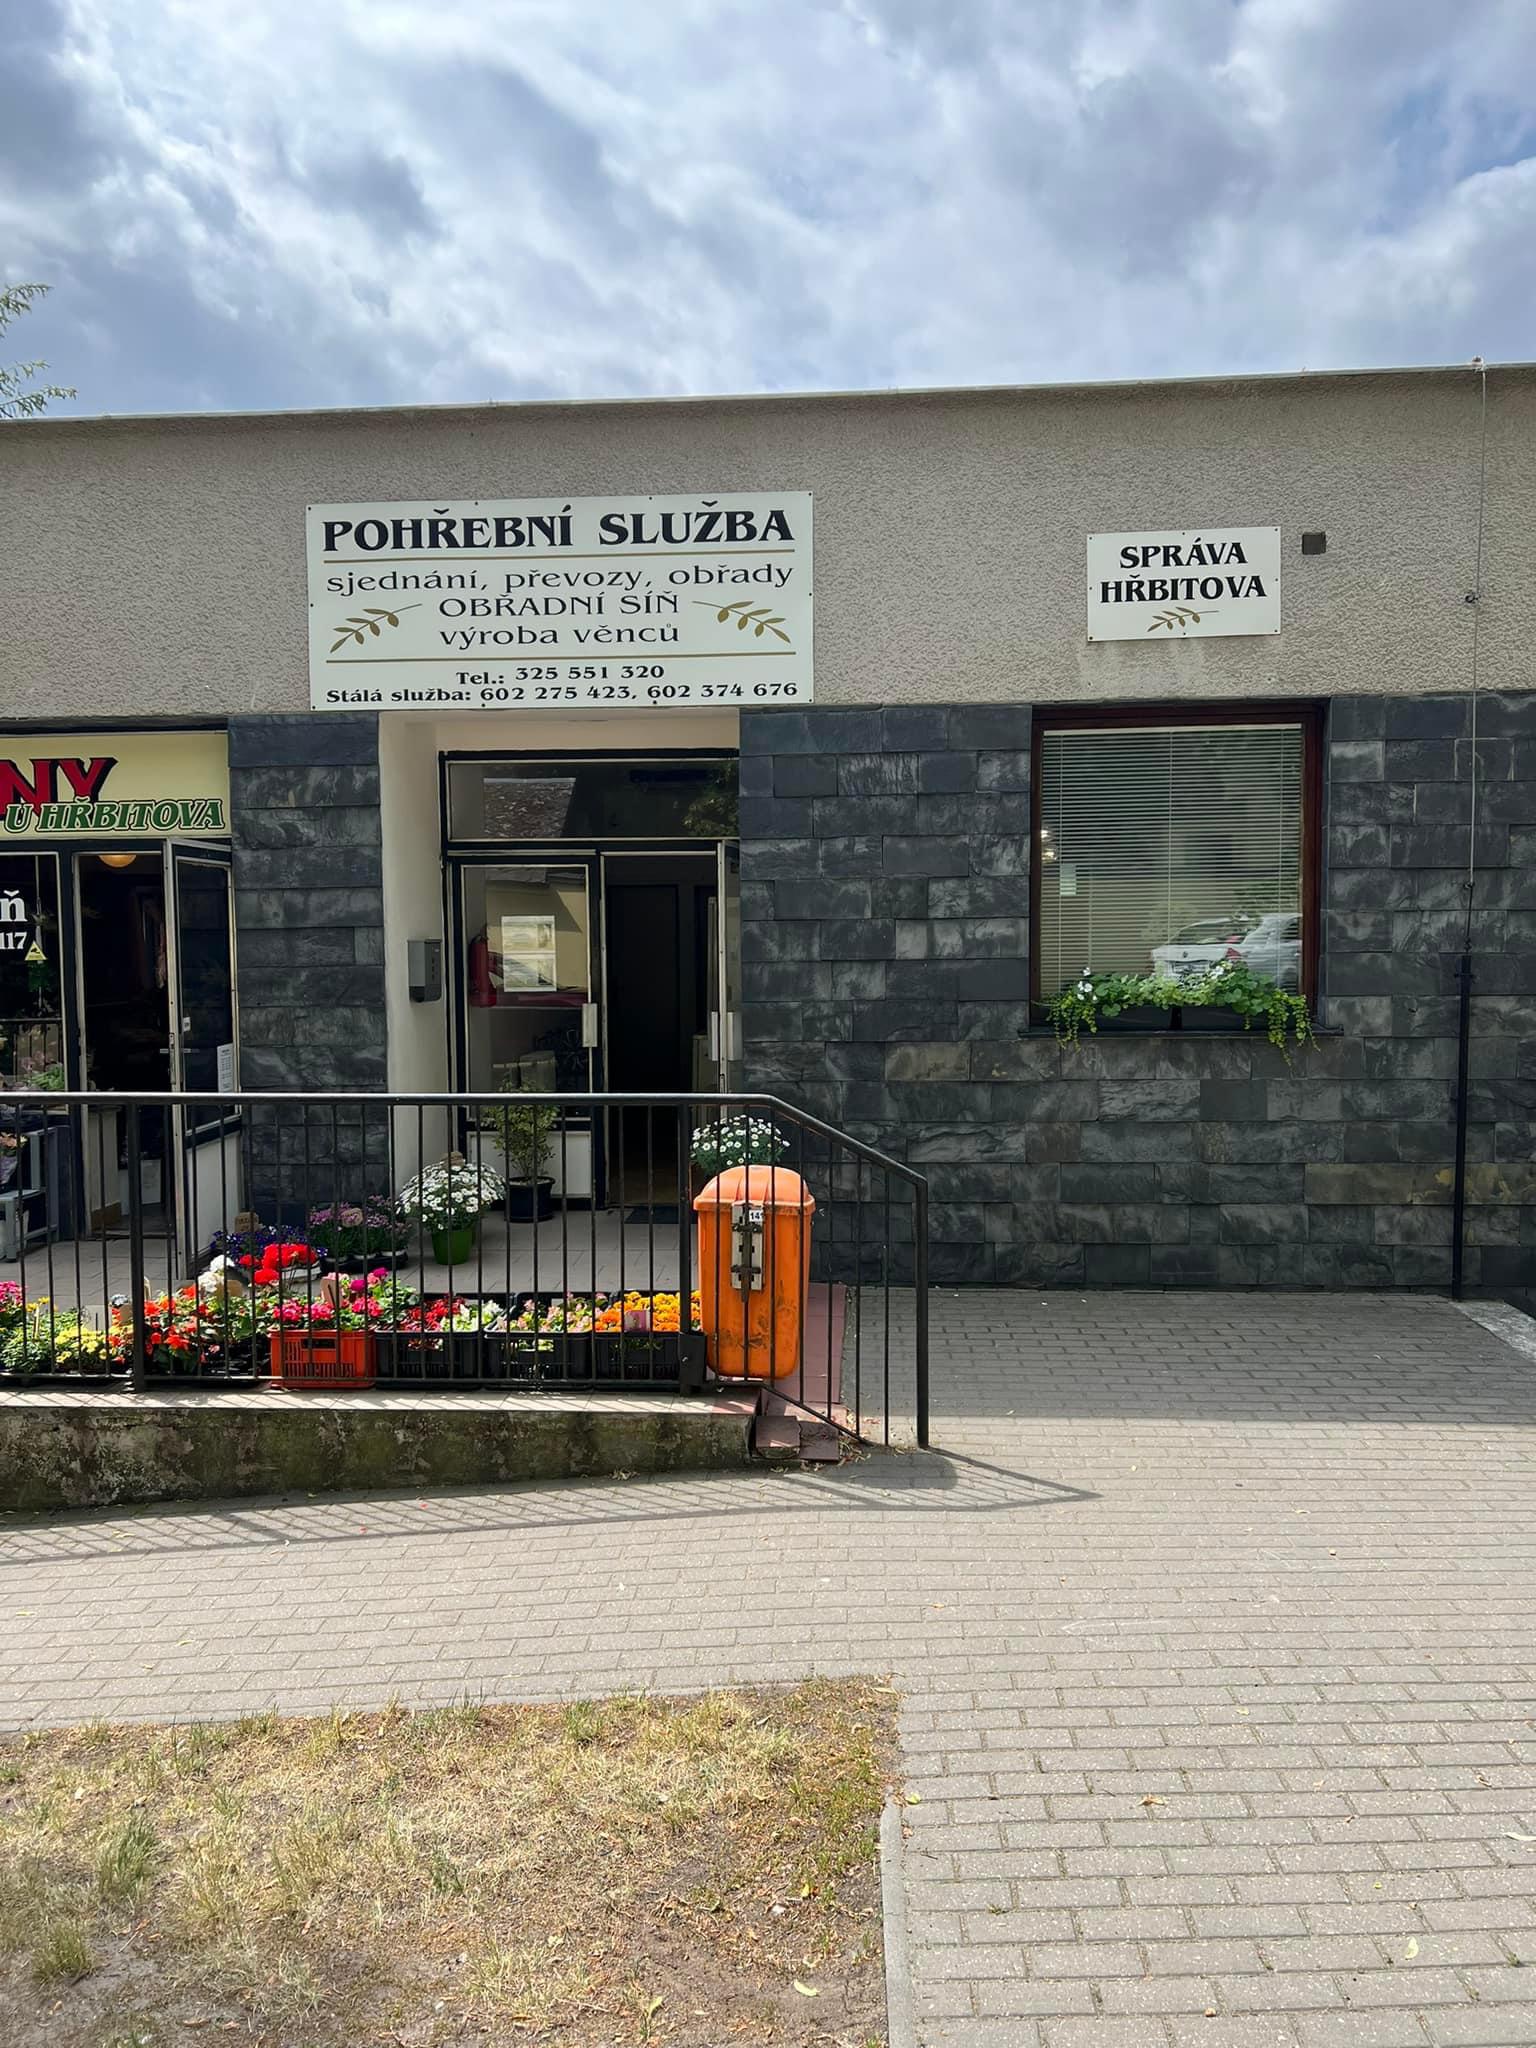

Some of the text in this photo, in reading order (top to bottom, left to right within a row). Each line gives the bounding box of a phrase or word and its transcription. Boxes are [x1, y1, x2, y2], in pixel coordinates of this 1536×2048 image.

[323, 500, 795, 551] POHŘEBNÍ SLUŽBA
[1119, 537, 1248, 569] SPRÁVA
[327, 564, 793, 596] sjednání, převozy, obřady
[1100, 574, 1267, 603] HŘBITOVA
[439, 590, 678, 617] OBŘADNÍ SÍŇ
[440, 623, 680, 650] výroba věnců
[456, 665, 665, 685] Tel.: 325 551 320
[326, 682, 798, 703] Stálá služba: 602 275 423, 602 374 676
[5, 796, 224, 832] U HŘBITOVA
